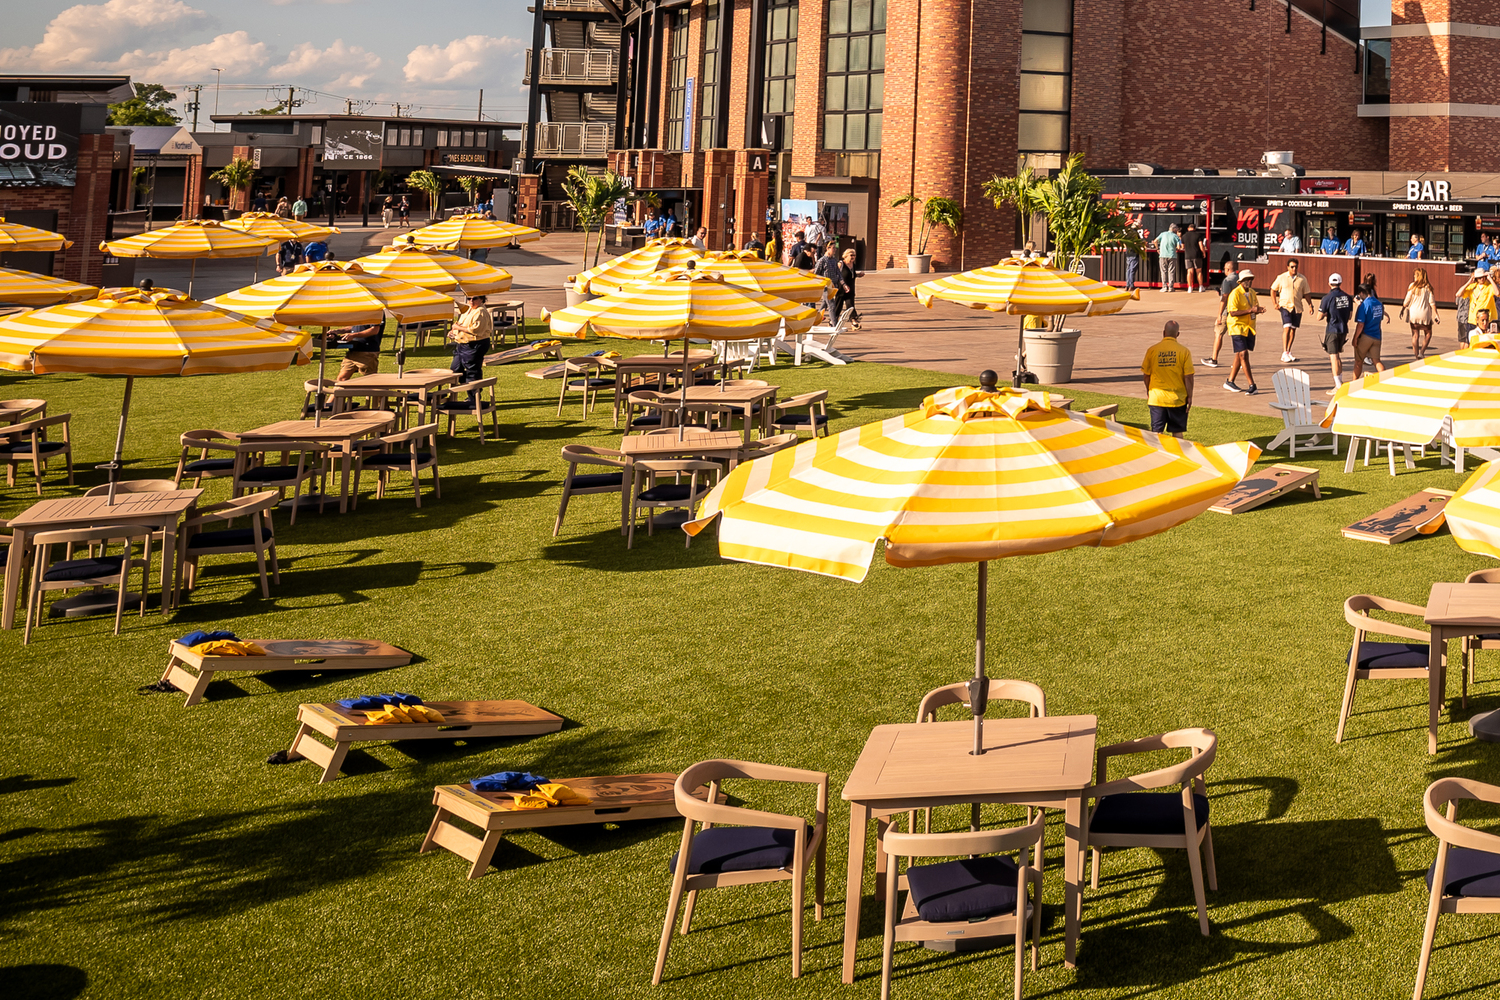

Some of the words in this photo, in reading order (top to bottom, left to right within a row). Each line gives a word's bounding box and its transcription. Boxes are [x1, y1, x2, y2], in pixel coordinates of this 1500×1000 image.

[0, 124, 57, 141] OYED
[753, 156, 763, 170] A
[1406, 179, 1450, 201] BAR
[1266, 199, 1284, 207] SPIRITS
[1287, 200, 1313, 208] COCKTAILS
[1316, 200, 1330, 208] BEER
[1416, 204, 1444, 212] COCKTAILS
[1448, 204, 1463, 212] BEER
[1237, 232, 1278, 244] BURER
